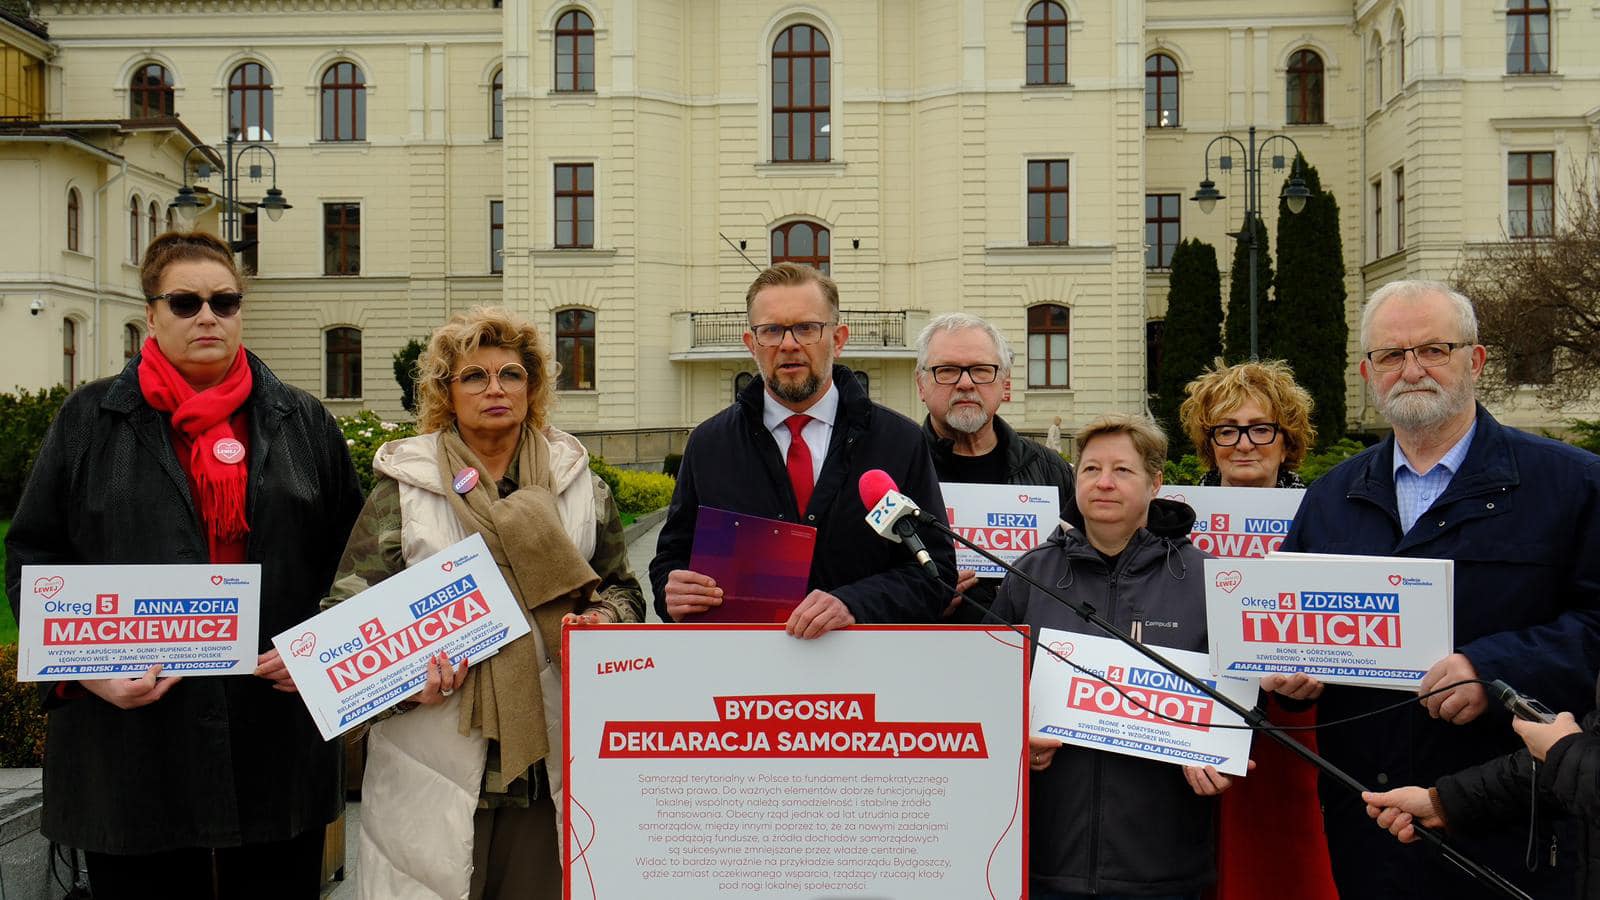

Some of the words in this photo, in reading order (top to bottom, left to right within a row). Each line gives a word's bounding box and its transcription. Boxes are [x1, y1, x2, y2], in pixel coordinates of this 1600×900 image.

[989, 514, 1034, 527] JERZY
[1215, 516, 1225, 529] 3
[1248, 520, 1289, 532] WIOL
[953, 528, 1035, 550] WACKI
[1193, 535, 1285, 556] OWAC
[414, 578, 473, 617] IZABELA
[1241, 597, 1276, 610] Okręg
[1280, 595, 1293, 608] 4
[1304, 594, 1396, 610] ZDZISŁAW
[44, 599, 92, 616] Okręg
[101, 597, 114, 612] 5
[136, 601, 185, 615] ANNA
[190, 600, 237, 614] ZOFIA
[50, 619, 232, 642] MACKIEWICZ
[1246, 612, 1397, 647] TYLICKI
[320, 637, 363, 663] Okręg
[365, 623, 382, 641] 2
[330, 596, 487, 690] NOWICKA
[596, 656, 655, 675] LEWICA
[1256, 654, 1300, 662] SZWEDEROWO
[1341, 657, 1377, 665] WOLNOŚCI
[46, 666, 78, 674] RAFAŁ
[80, 664, 113, 672] BRUSKI
[174, 661, 233, 669] BYDGOSZCZY
[1109, 668, 1121, 681] 4
[1234, 663, 1263, 671] RAFAŁ
[1264, 664, 1297, 673] BRUSKI
[1304, 666, 1336, 675] RAZEM
[1337, 667, 1356, 675] DLA
[1358, 669, 1422, 679] BYDGOSZCZY
[345, 704, 373, 722] RAFAŁ
[372, 687, 403, 709] BRUSKI
[407, 675, 427, 688] RAZ
[454, 630, 505, 663] BYDGOSZCZY
[725, 699, 863, 721] BYDGOSKA
[1072, 681, 1208, 725] POCIOT
[609, 731, 770, 753] DEKLARACJA
[777, 731, 979, 757] SAMORZĄDOWA
[1046, 726, 1074, 738] RAFAŁ
[1075, 732, 1106, 743] BRUSKI
[1112, 739, 1143, 750] RAZEM
[1143, 744, 1162, 753] DLA
[1163, 747, 1222, 764] BYDGOSZCZY
[638, 774, 688, 784] Samorząd
[692, 774, 744, 784] terytorialny
[758, 774, 790, 783] Polsce
[804, 774, 858, 783] fundament
[860, 774, 948, 784] demokratycznego
[641, 786, 684, 796] państwa
[686, 787, 720, 796] prawa.
[784, 786, 838, 795] elementów
[840, 786, 874, 795] dobrze
[876, 786, 946, 796] funkcjonującej
[656, 798, 692, 808] lokalnej
[695, 798, 744, 808] wspólnoty
[746, 798, 779, 808] należą
[782, 798, 852, 807] samodzielność
[860, 798, 898, 807] stabilne
[656, 810, 722, 819] finansowania.
[726, 810, 766, 820] Obecny
[767, 810, 788, 820] rząd
[790, 810, 824, 820] jednak
[842, 810, 856, 819] lat
[858, 810, 898, 819] utrudnia
[638, 822, 702, 832] samorządów,
[704, 822, 740, 832] między
[742, 822, 772, 832] innymi
[774, 823, 813, 832] poprzez
[816, 822, 828, 832] to,
[858, 822, 895, 832] nowymi
[898, 822, 949, 831] zadaniami
[648, 834, 663, 843] nie
[714, 834, 760, 844] fundusze,
[859, 834, 940, 844] samorządowych
[682, 845, 742, 856] sukcesywnie
[744, 845, 804, 856] zmniejszane
[806, 847, 832, 856] przez
[834, 845, 868, 854] władze
[870, 845, 918, 854] centralne.
[635, 856, 668, 865] Widać
[682, 856, 717, 865] bardzo
[720, 856, 762, 867] wyraźnie
[780, 856, 835, 867] przykładzie
[836, 856, 891, 867] samorządu
[893, 856, 952, 867] Bydgoszczy,
[642, 869, 670, 880] gdzie
[672, 869, 710, 878] zamiast
[712, 869, 782, 880] oczekiwanego
[784, 869, 832, 880] wsparcia,
[833, 869, 878, 880] rządzący
[880, 869, 916, 880] rzucają
[918, 869, 945, 880] kłody
[718, 880, 739, 891] pod
[741, 880, 763, 891] nogi
[765, 880, 801, 891] lokalnej
